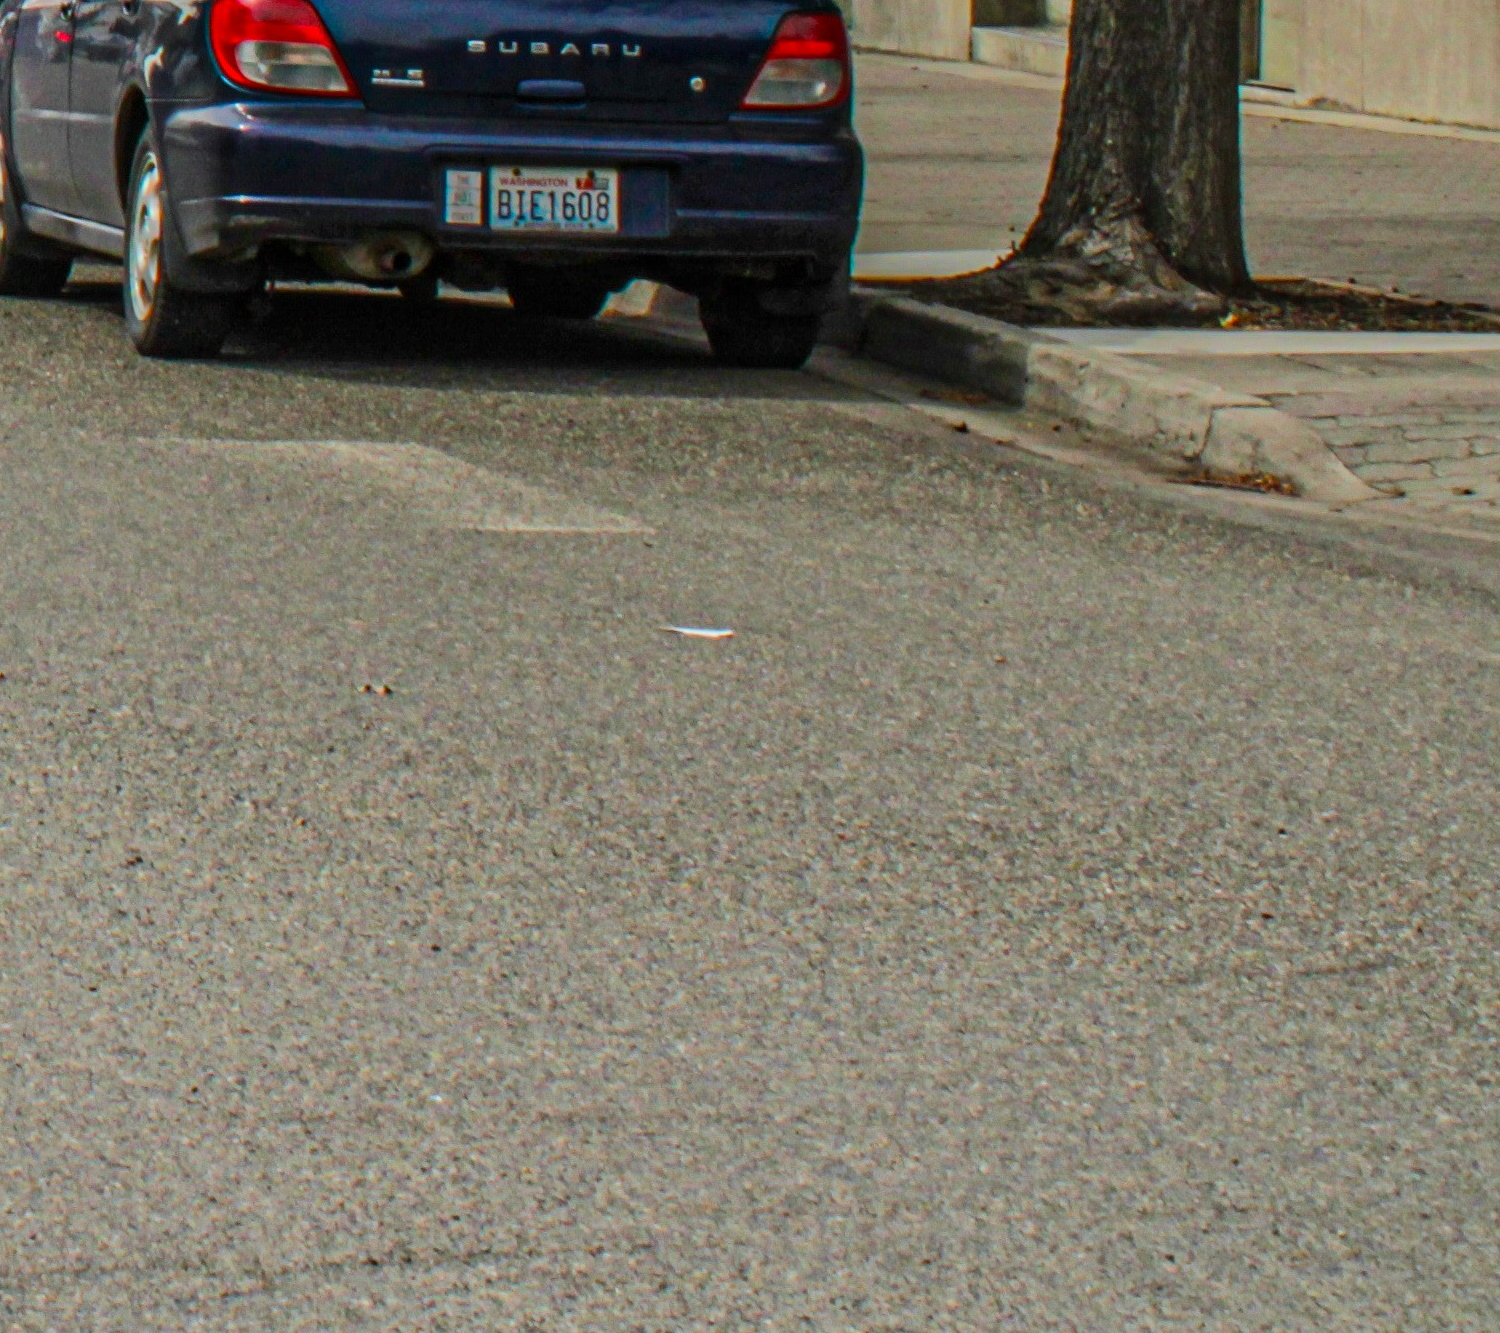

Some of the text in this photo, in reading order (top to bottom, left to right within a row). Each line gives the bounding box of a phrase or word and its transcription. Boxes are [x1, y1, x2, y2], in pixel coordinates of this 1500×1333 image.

[467, 39, 641, 56] SUBARU
[499, 177, 568, 188] WASHINGTON
[497, 189, 610, 222] BIE1608
